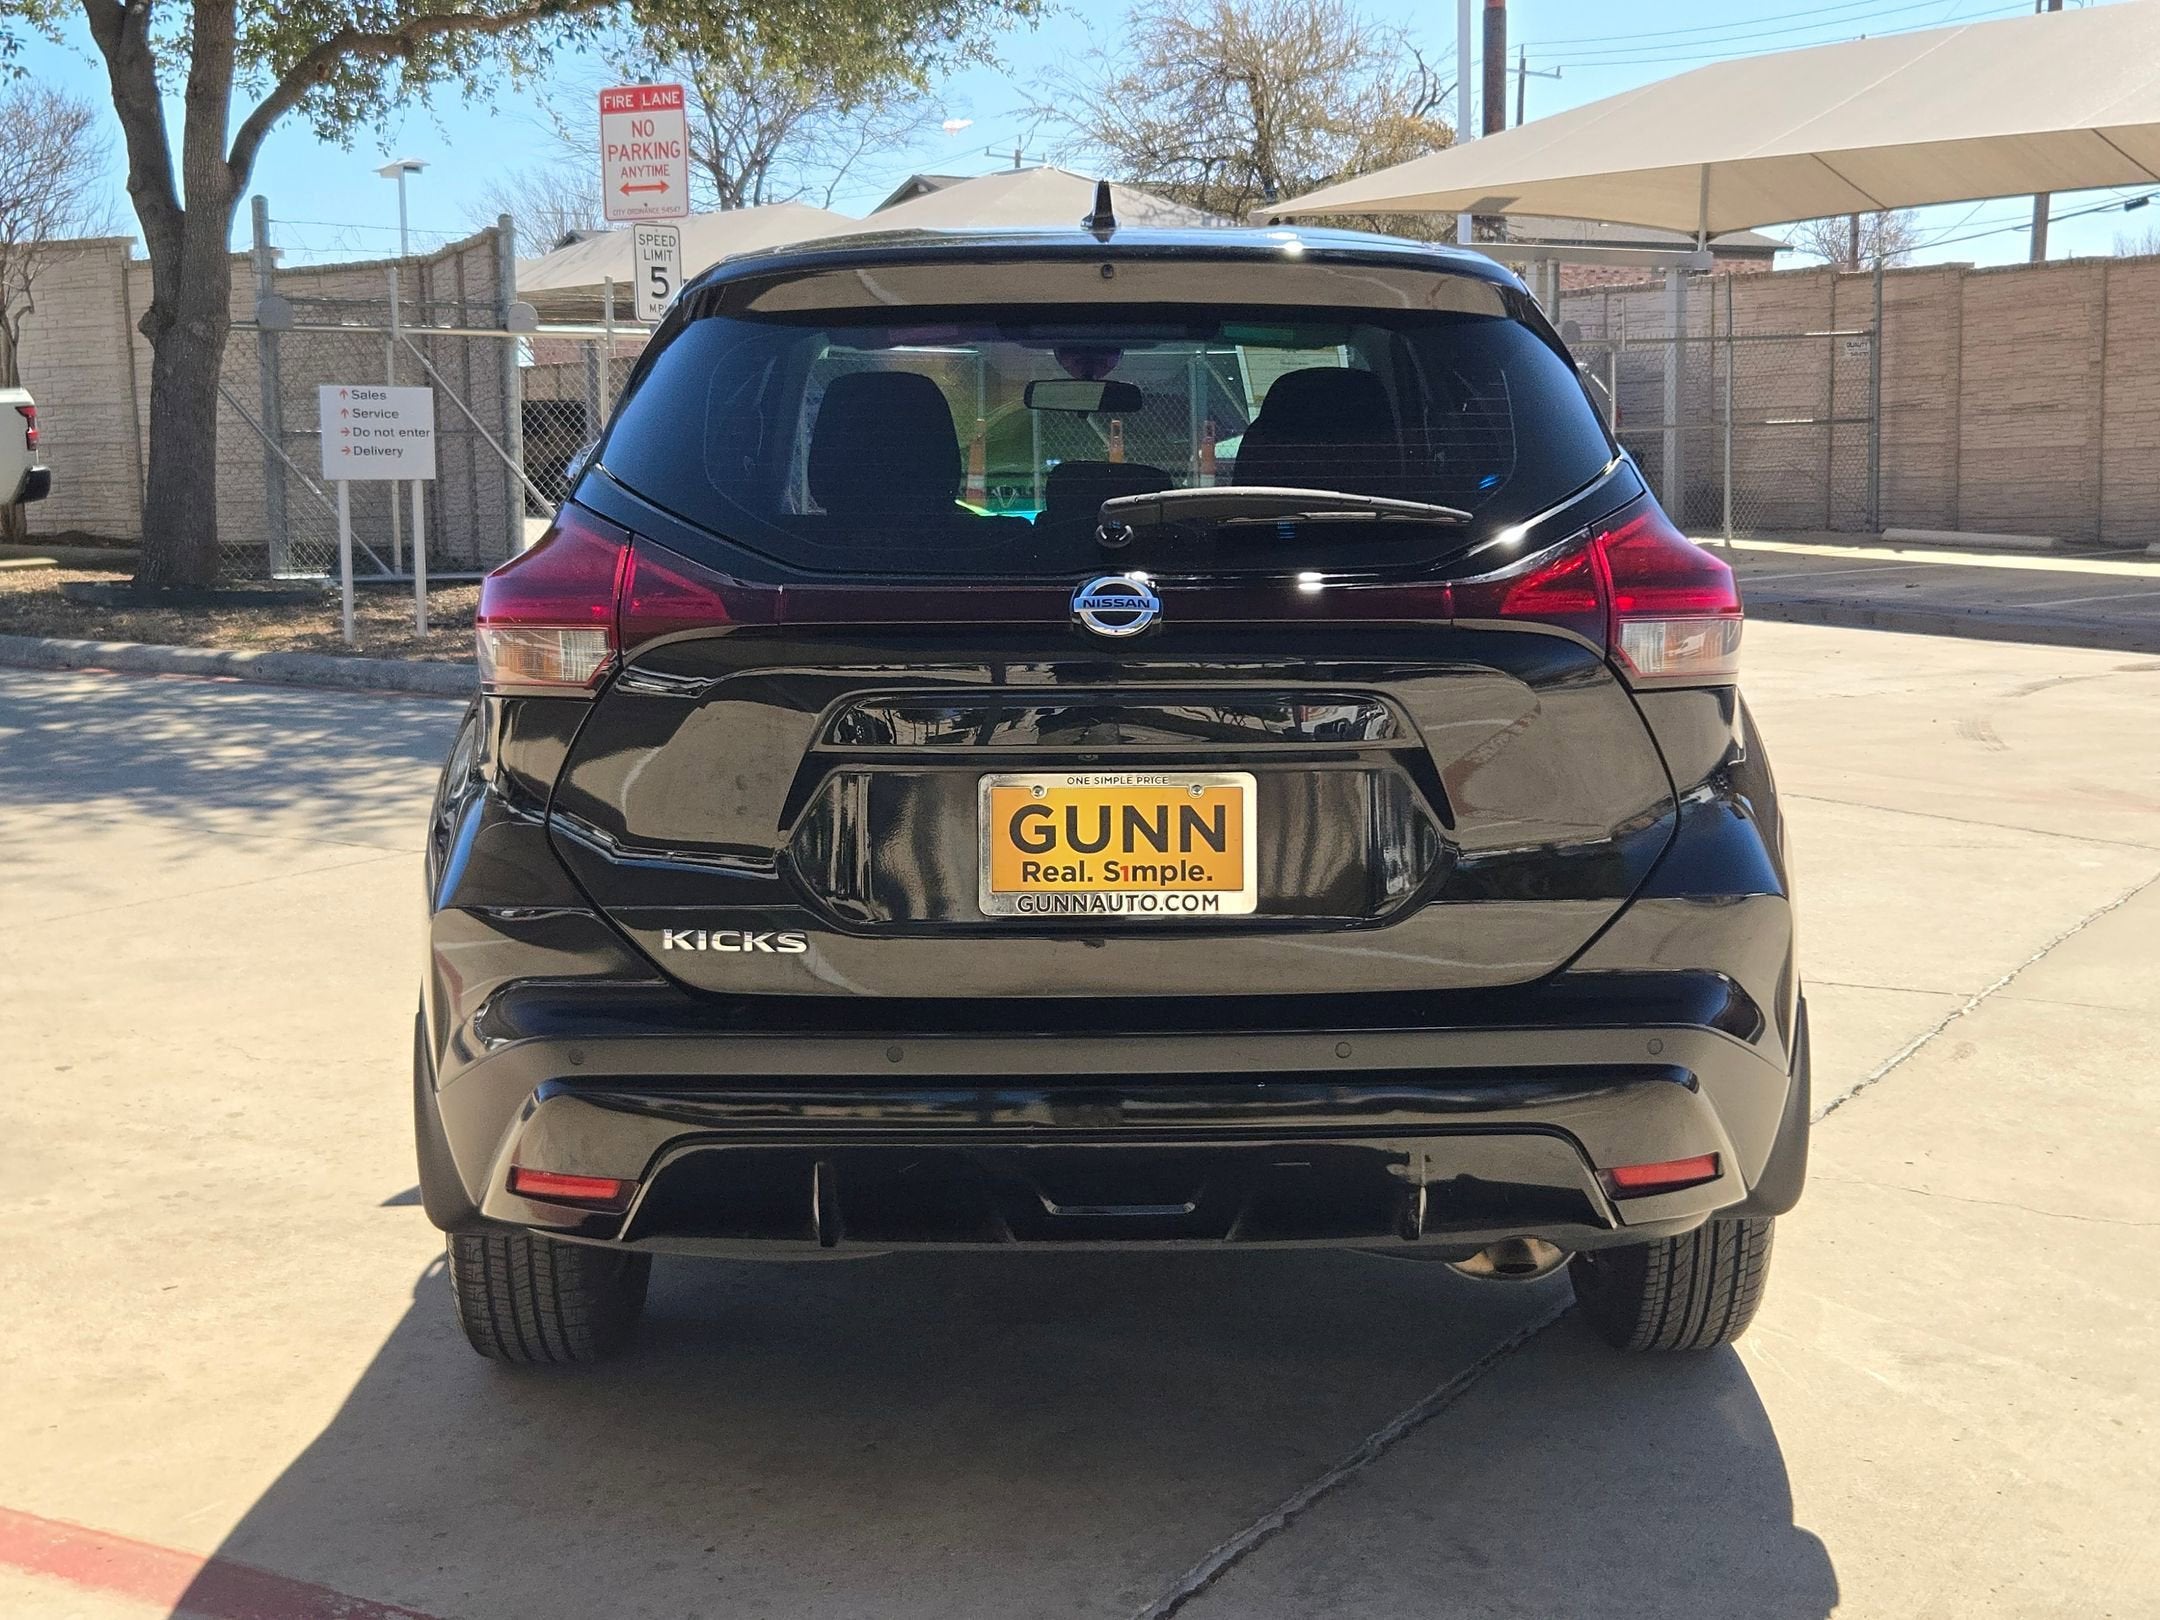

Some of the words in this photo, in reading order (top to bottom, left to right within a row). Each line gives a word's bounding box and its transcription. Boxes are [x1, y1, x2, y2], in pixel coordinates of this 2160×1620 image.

[604, 95, 634, 109] FIRE
[642, 91, 681, 107] LANE
[631, 119, 655, 138] NO
[607, 140, 681, 162] PARKING
[620, 164, 670, 179] ANYTIME
[638, 234, 676, 247] SPEED
[643, 249, 673, 261] LIMIT
[650, 266, 670, 299] 5
[351, 389, 387, 400] Sales
[352, 408, 399, 419] Service
[352, 427, 371, 438] Do
[374, 428, 395, 438] not
[398, 428, 431, 438] enter
[353, 445, 404, 458] Delivery
[1082, 598, 1150, 609] NISSAN
[1066, 776, 1091, 785] ONE
[1094, 776, 1133, 785] SIMPLE
[1136, 775, 1169, 785] PRICE
[1009, 803, 1226, 854] GUNN
[1022, 860, 1093, 883] Real.
[1017, 894, 1219, 912] GUNNAUTO.COM
[663, 928, 808, 953] KICKS
